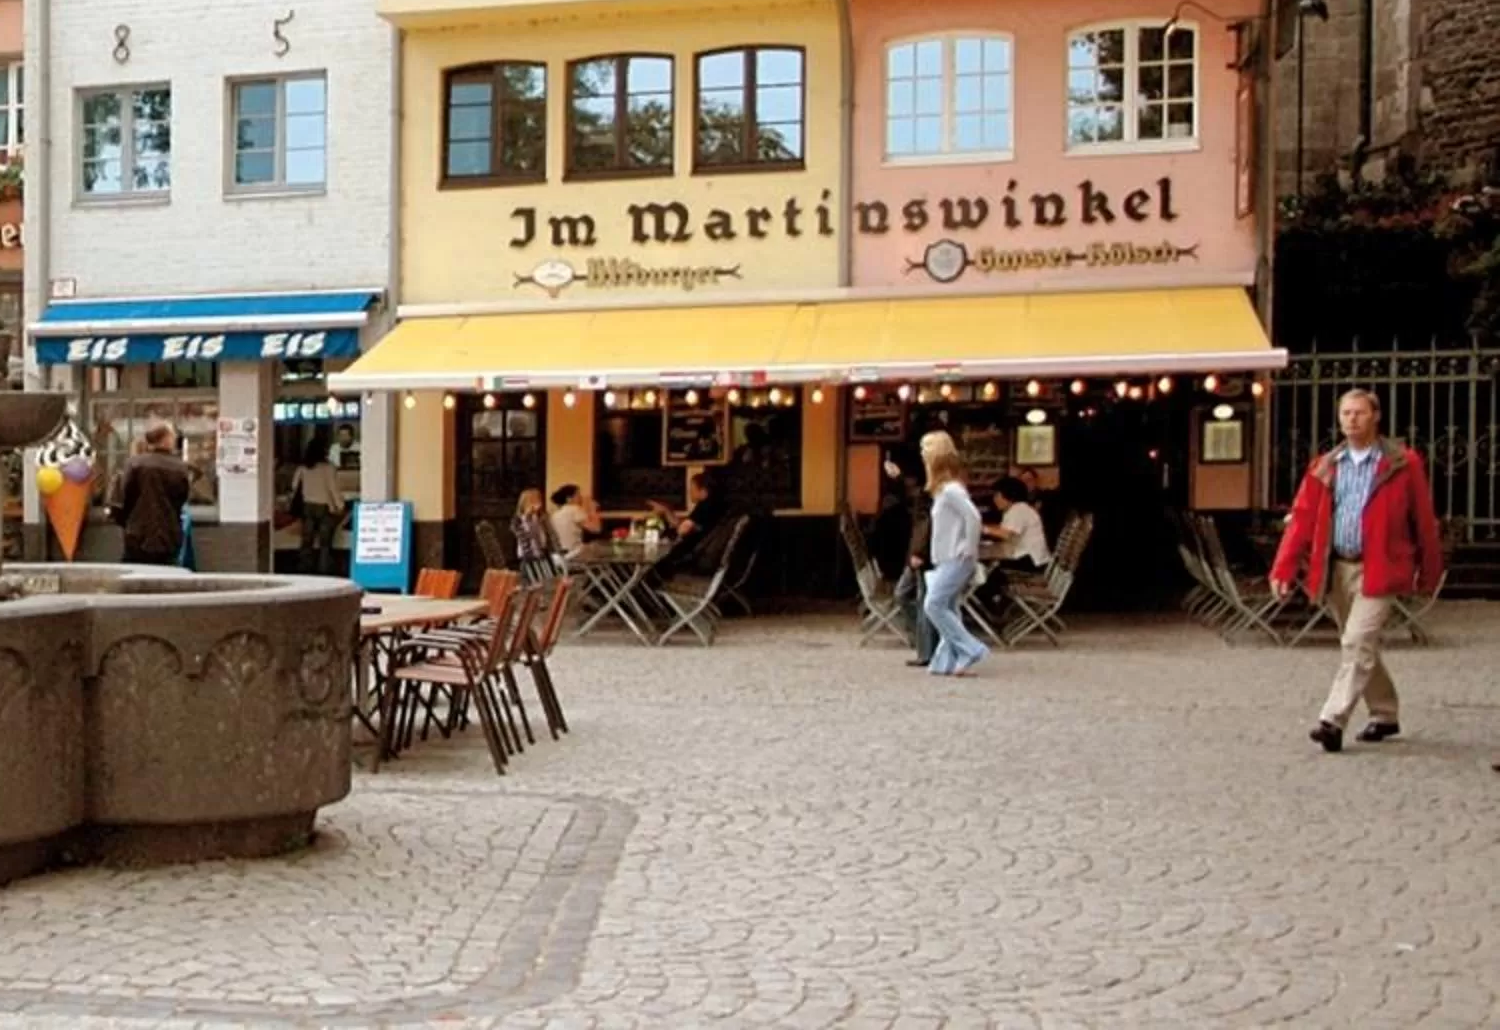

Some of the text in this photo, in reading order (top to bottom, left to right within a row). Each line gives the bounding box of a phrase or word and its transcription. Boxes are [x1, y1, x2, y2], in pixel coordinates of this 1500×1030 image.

[111, 9, 295, 65] 8 5
[628, 176, 1179, 245] Martinswinkel
[66, 337, 129, 362] EIS
[161, 334, 226, 361] EIS
[260, 331, 326, 358] EIS
